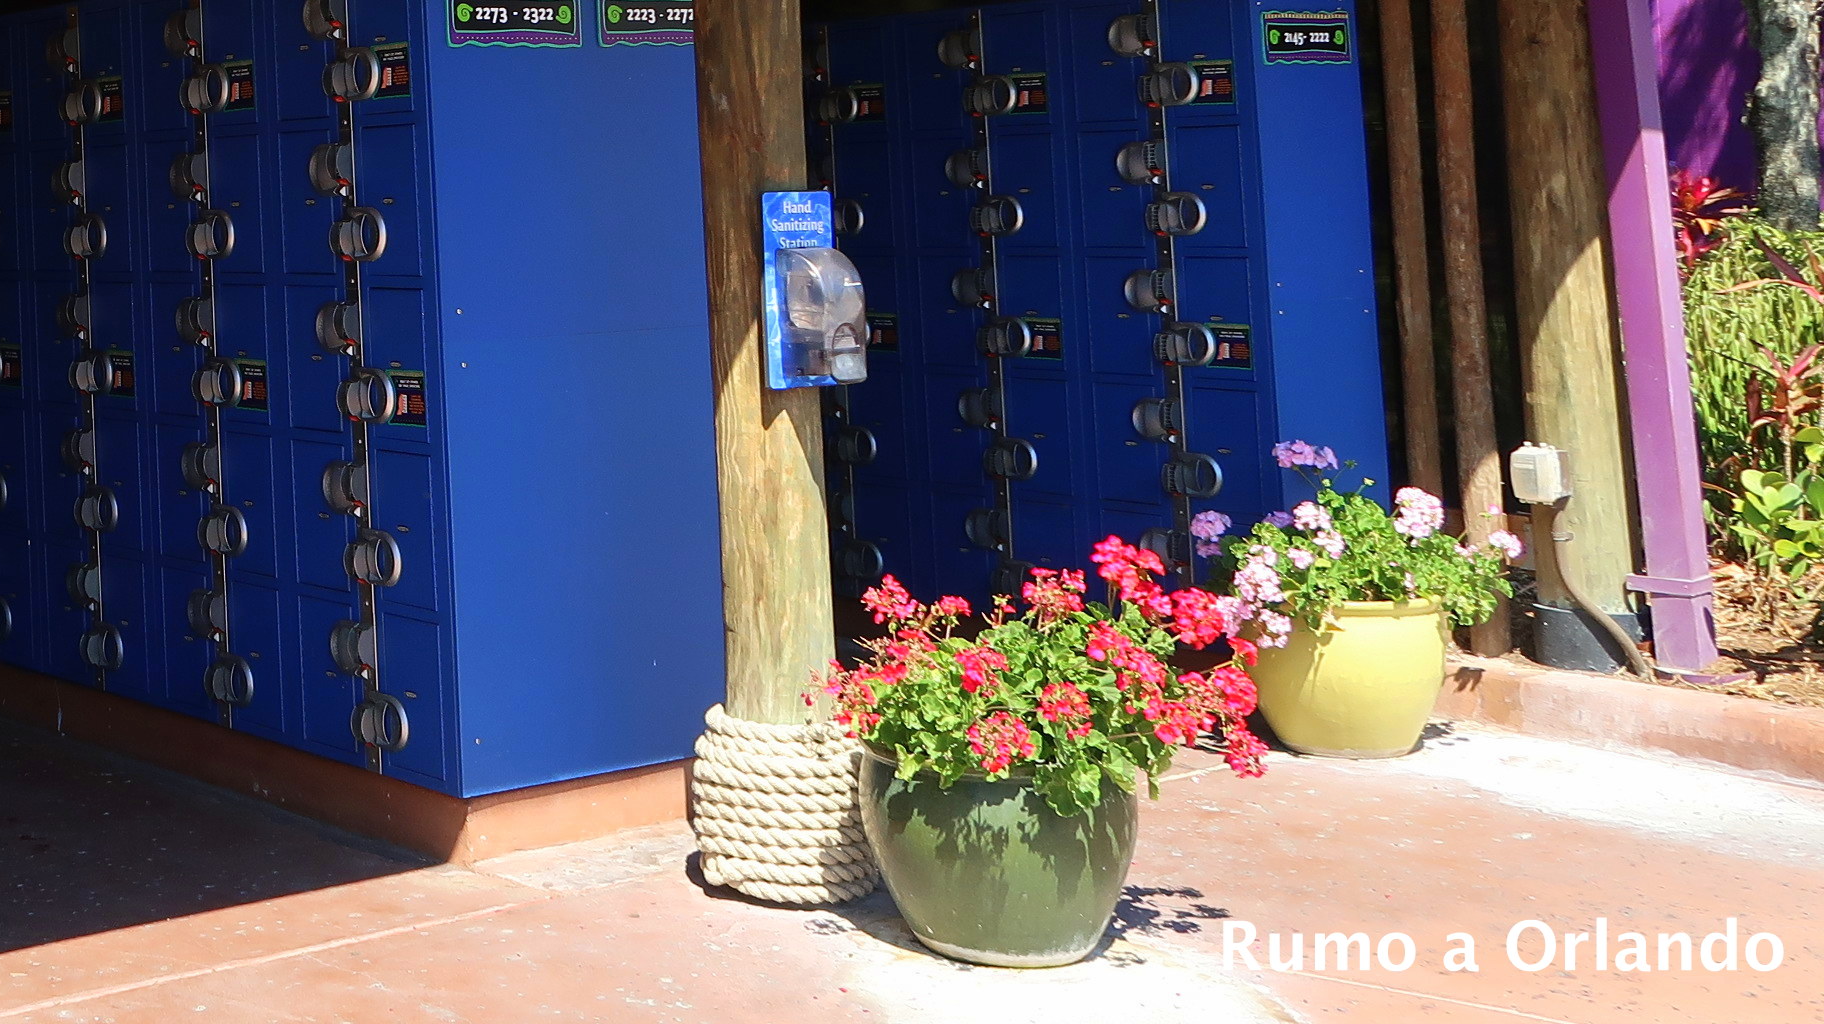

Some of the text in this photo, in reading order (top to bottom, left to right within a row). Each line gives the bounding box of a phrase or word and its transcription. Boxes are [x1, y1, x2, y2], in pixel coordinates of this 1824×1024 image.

[475, 7, 508, 24] 2273
[522, 7, 554, 24] 2322
[626, 8, 656, 24] 2223
[666, 8, 693, 24] 2272
[1309, 32, 1330, 43] 2222
[783, 199, 812, 214] Hand
[771, 217, 825, 234] Sanitizing
[779, 235, 818, 249] Station
